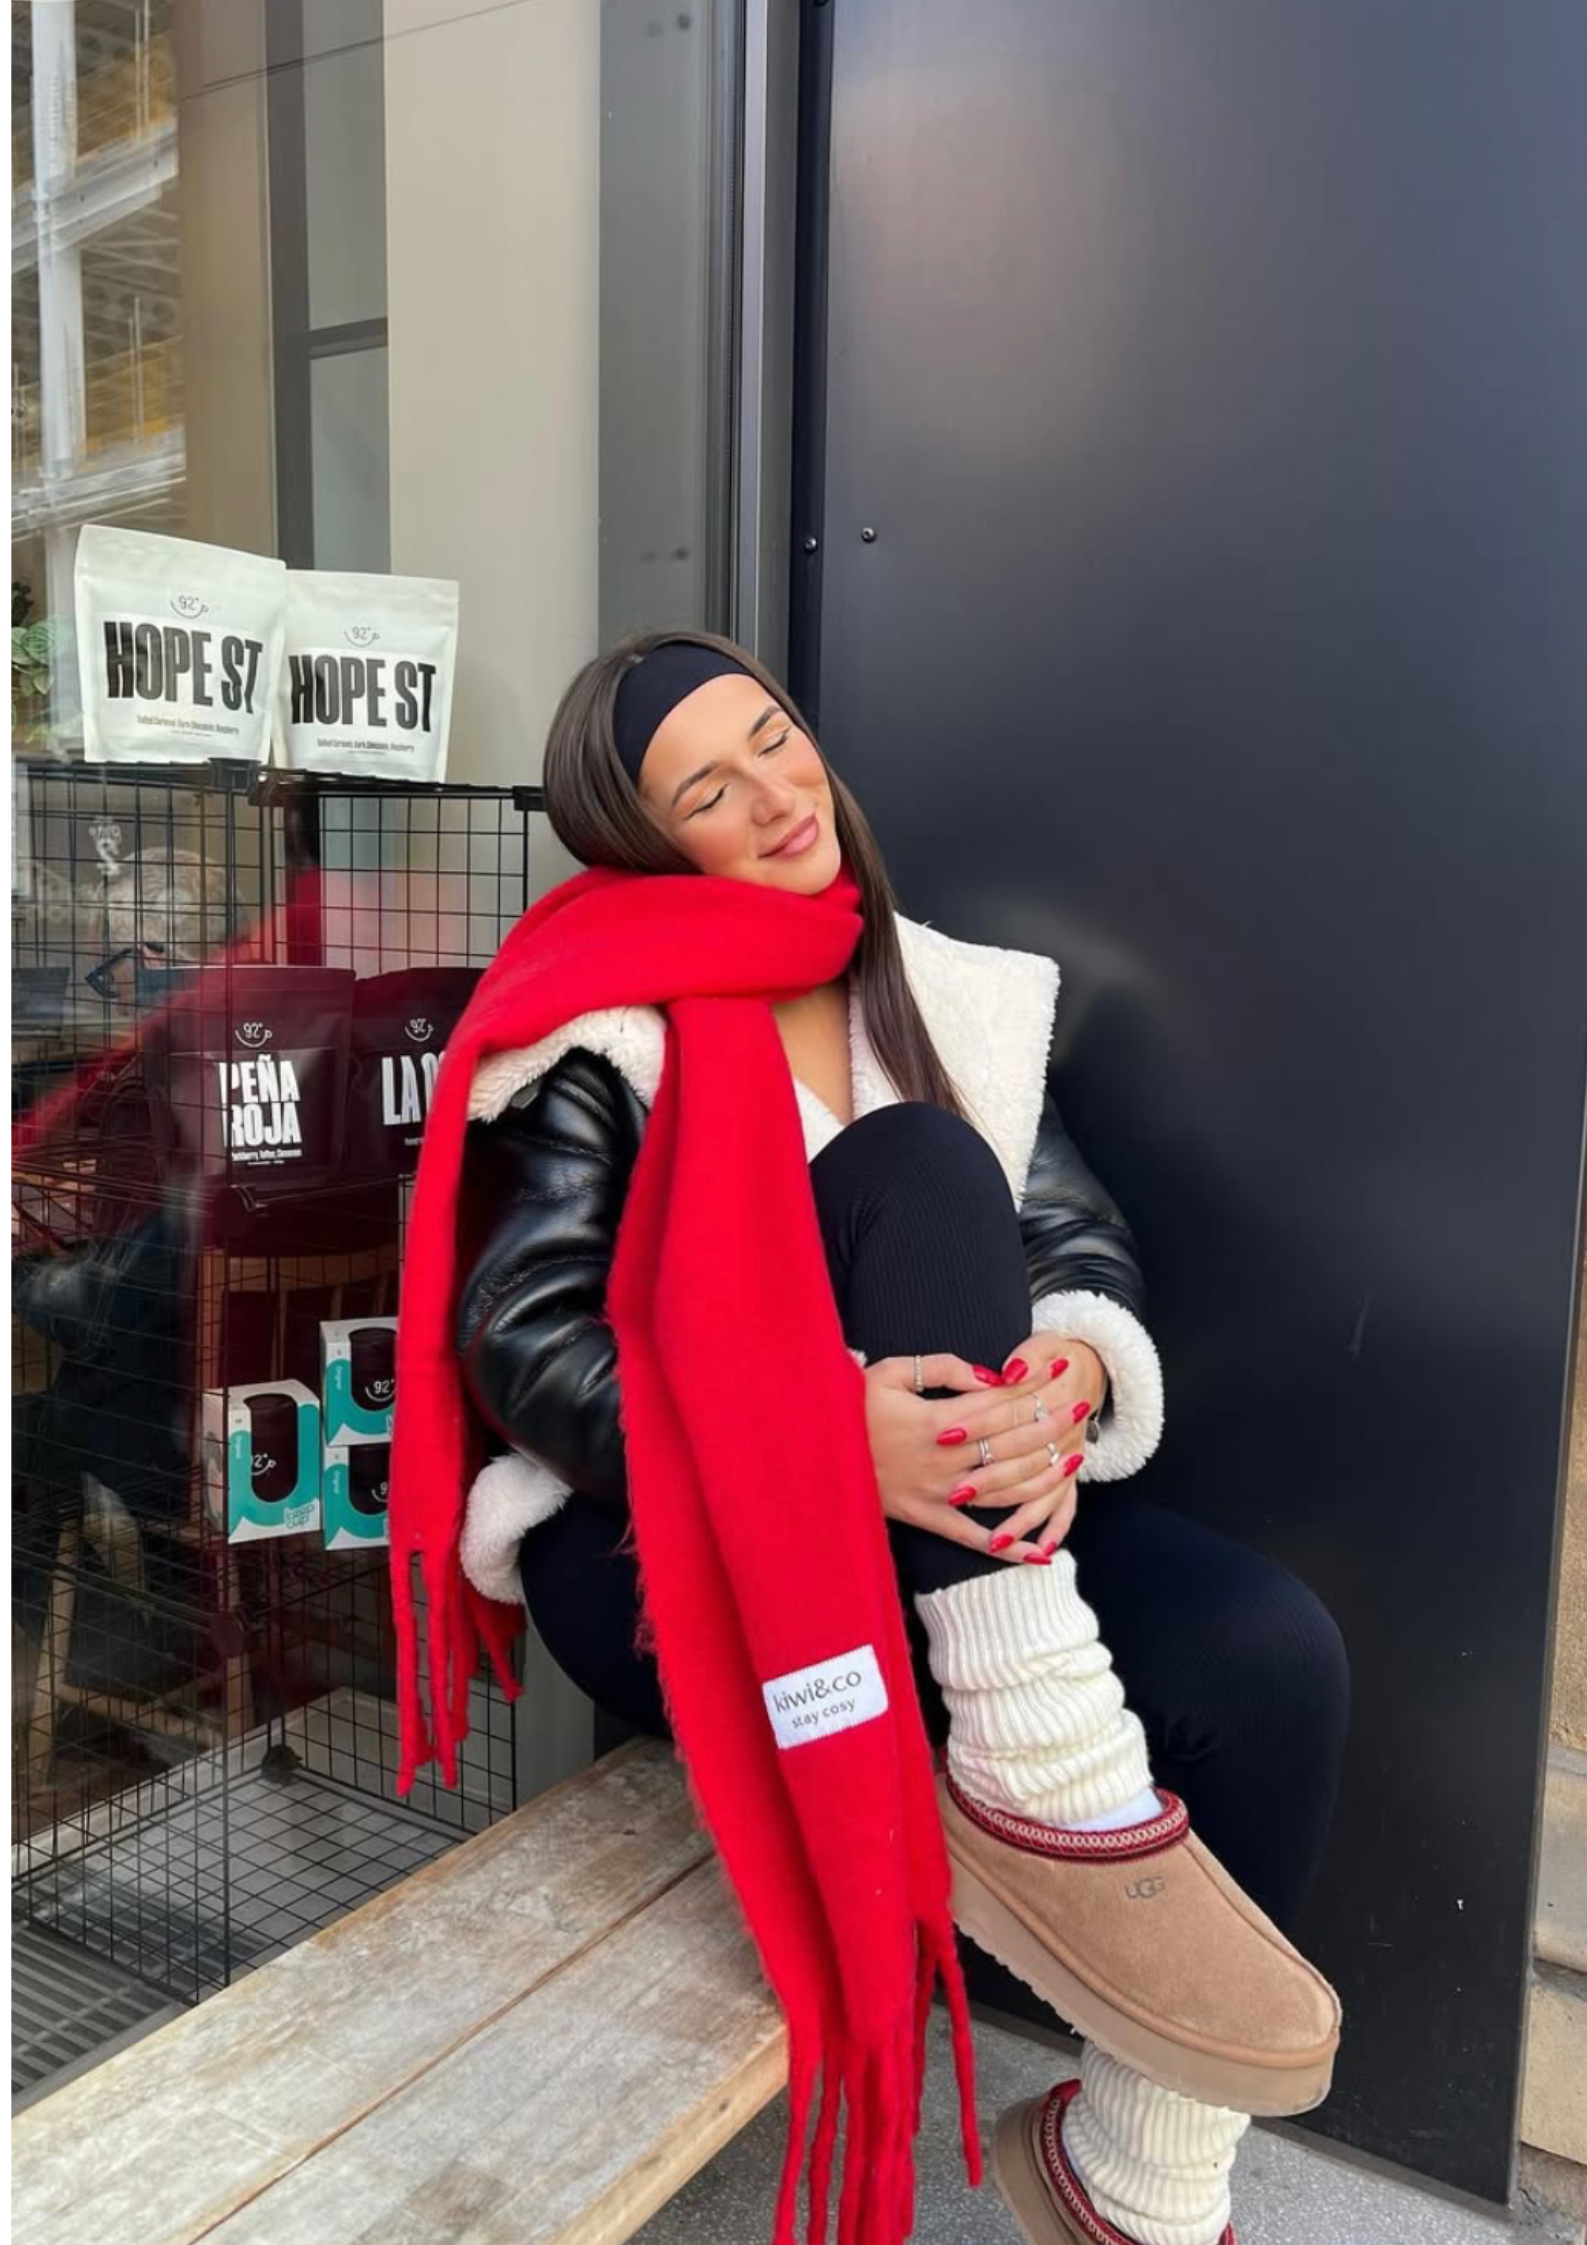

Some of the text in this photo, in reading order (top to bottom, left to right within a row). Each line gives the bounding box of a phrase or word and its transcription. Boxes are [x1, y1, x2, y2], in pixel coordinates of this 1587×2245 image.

[103, 621, 263, 714] HOPE ST
[288, 654, 436, 732] HOPE ST
[219, 1054, 300, 1103] PEÑA
[222, 1102, 302, 1147] ROJA
[773, 1671, 862, 1713] kiwi&co
[792, 1699, 855, 1729] stay cosy
